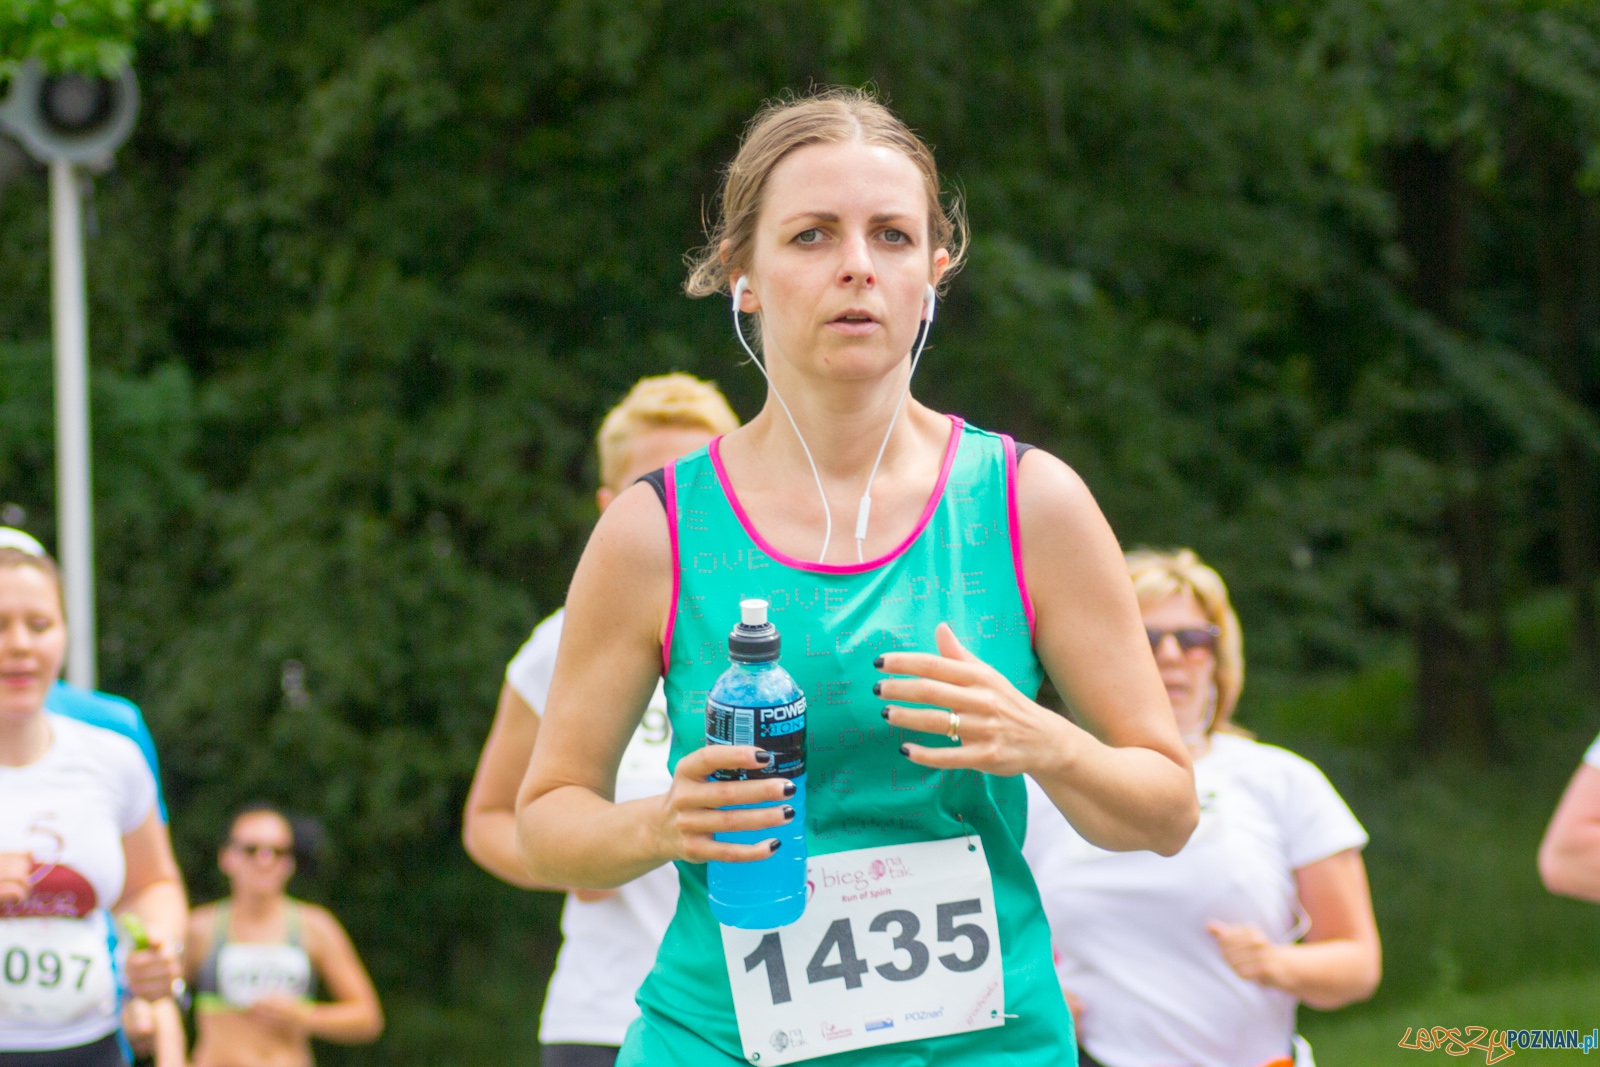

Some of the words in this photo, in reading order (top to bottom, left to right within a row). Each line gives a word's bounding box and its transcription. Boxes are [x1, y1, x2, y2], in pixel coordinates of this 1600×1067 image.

[821, 867, 869, 891] bieg
[888, 865, 914, 879] tak
[841, 893, 858, 903] Run
[859, 891, 868, 900] of
[870, 887, 892, 899] Spirit
[743, 897, 990, 1006] 1435
